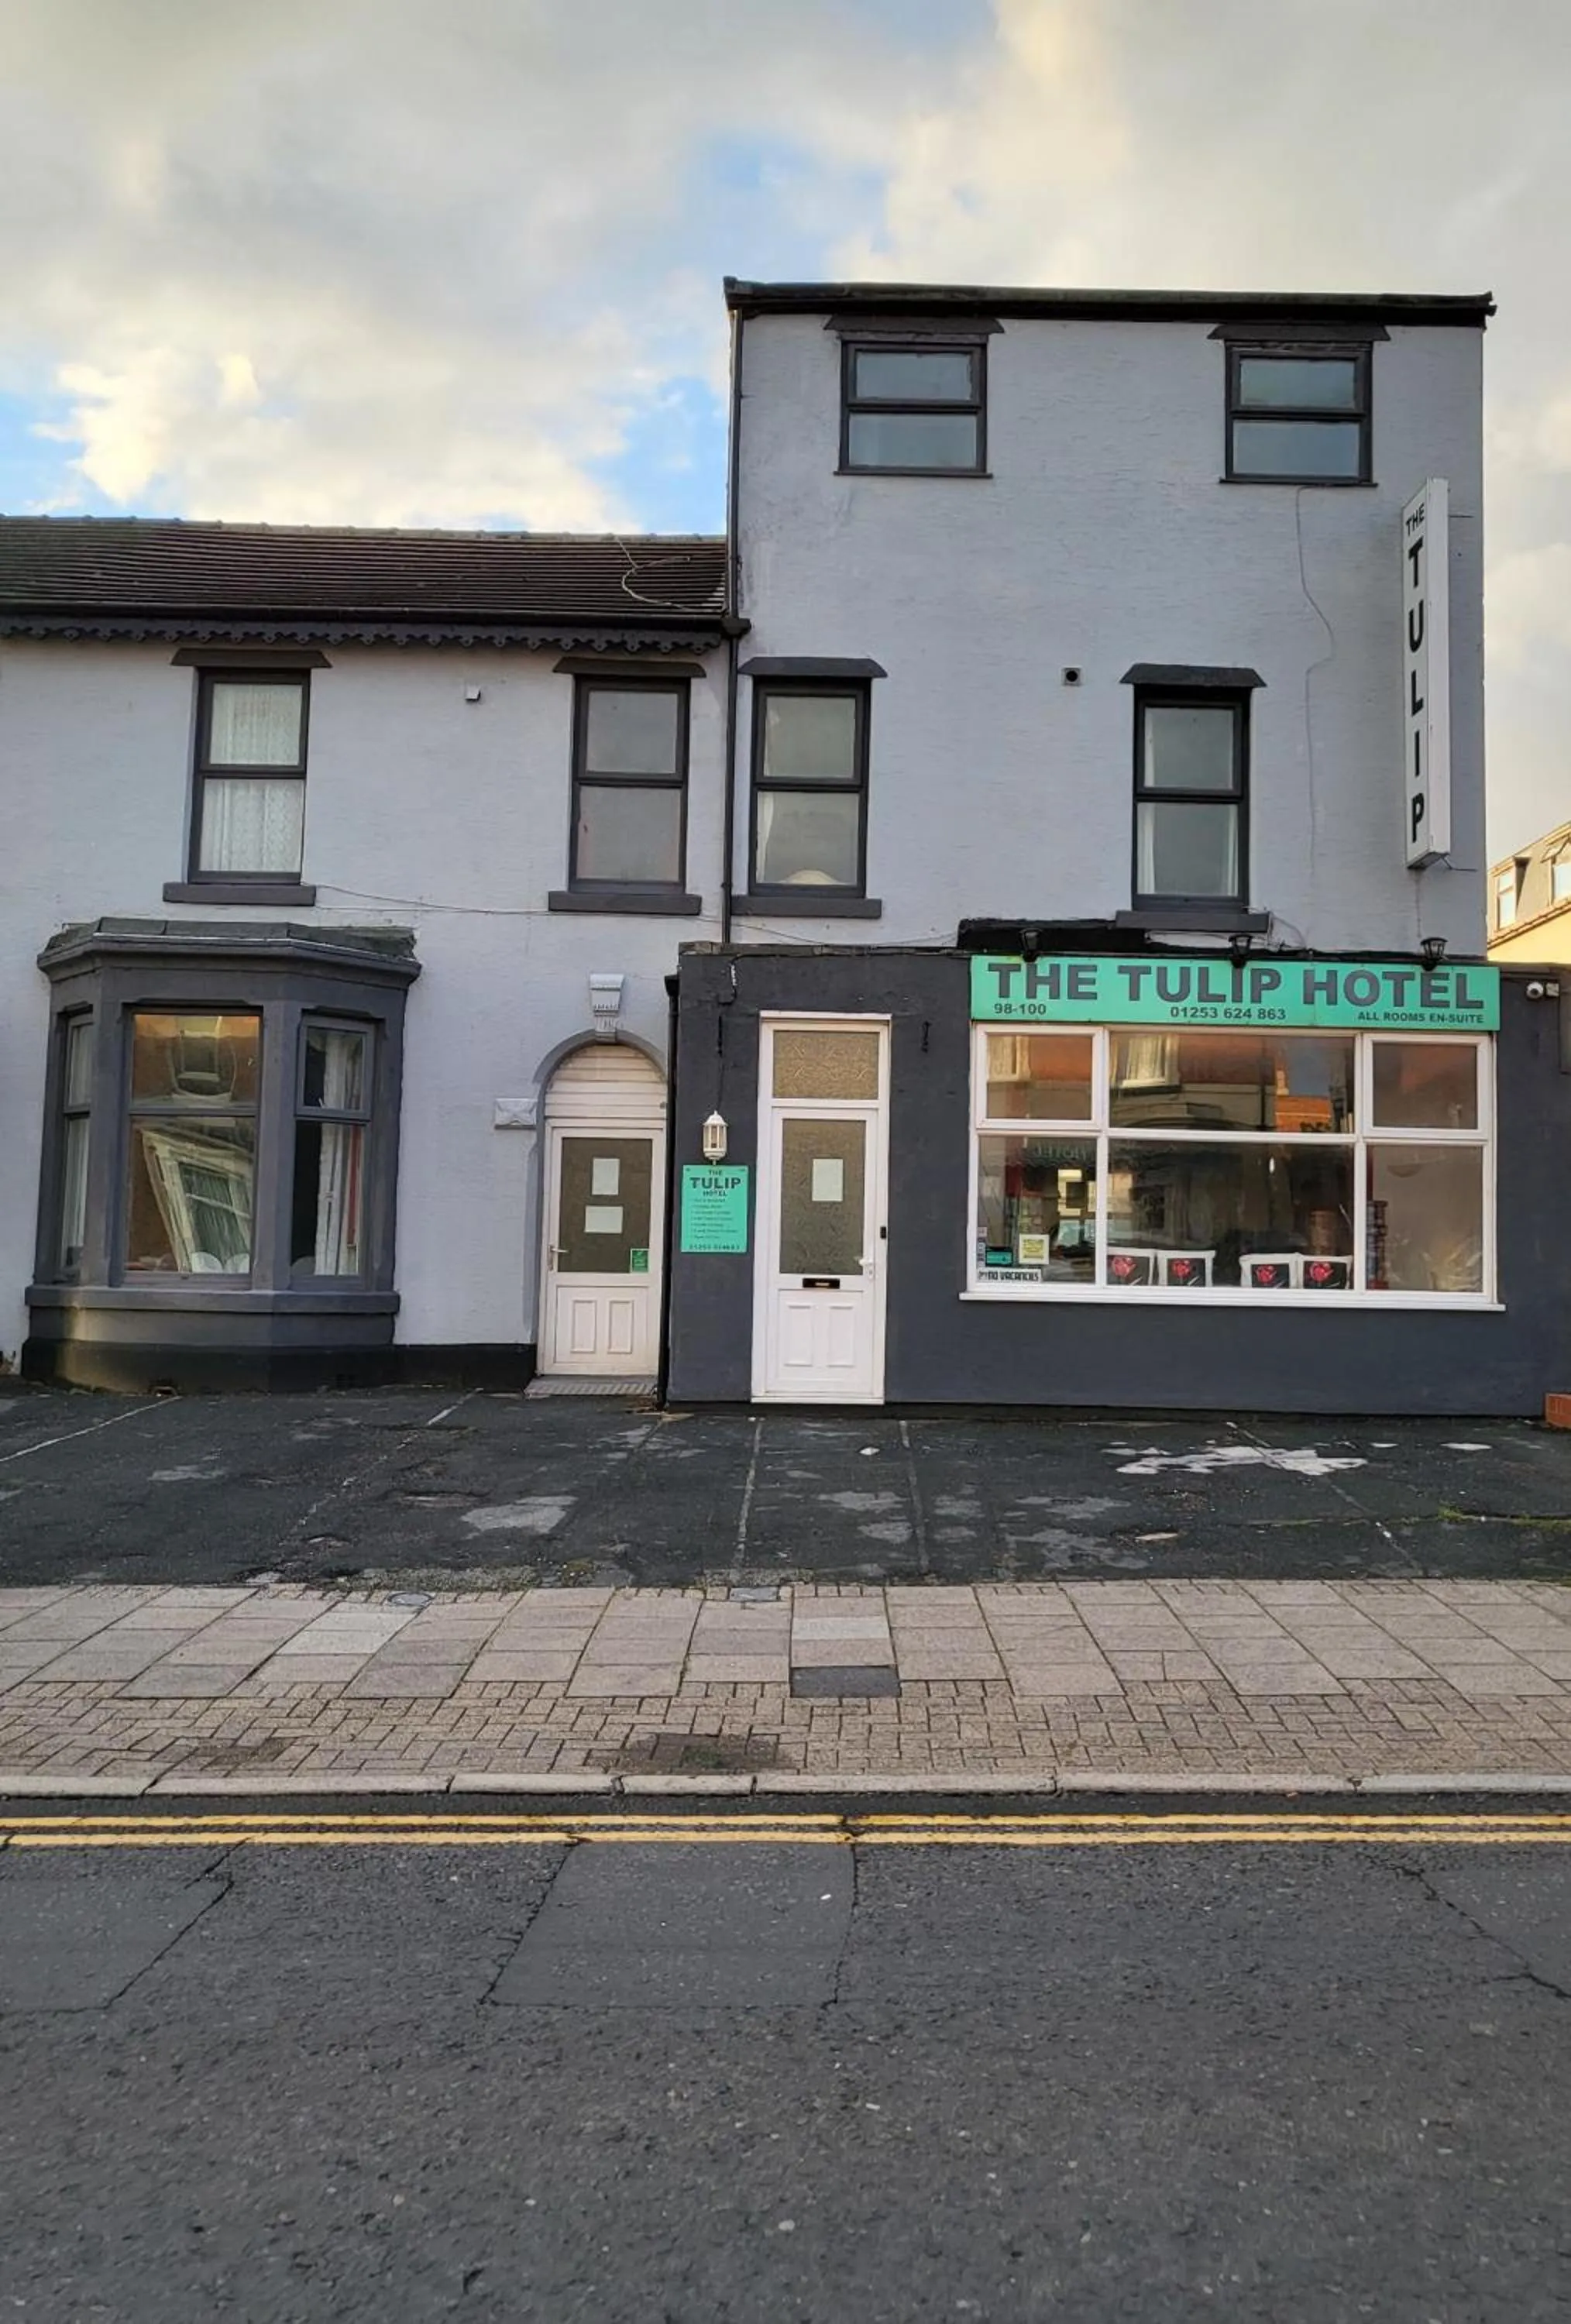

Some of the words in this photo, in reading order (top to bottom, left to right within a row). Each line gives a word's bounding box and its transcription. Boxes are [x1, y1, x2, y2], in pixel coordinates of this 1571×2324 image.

[1405, 503, 1425, 537] THE
[1408, 536, 1425, 843] TULIP
[988, 962, 1098, 1000] THE
[1117, 964, 1282, 1005] TULIP
[1302, 968, 1485, 1009] HOTEL
[993, 1002, 1047, 1016] 98-100
[1170, 1006, 1218, 1019] 01253
[1223, 1007, 1253, 1020] 624
[1256, 1008, 1287, 1021] 863
[1357, 1011, 1380, 1022] ALL
[1383, 1012, 1426, 1023] ROOMS
[1428, 1012, 1485, 1024] EN-SUITE
[689, 1177, 741, 1189] TULIP
